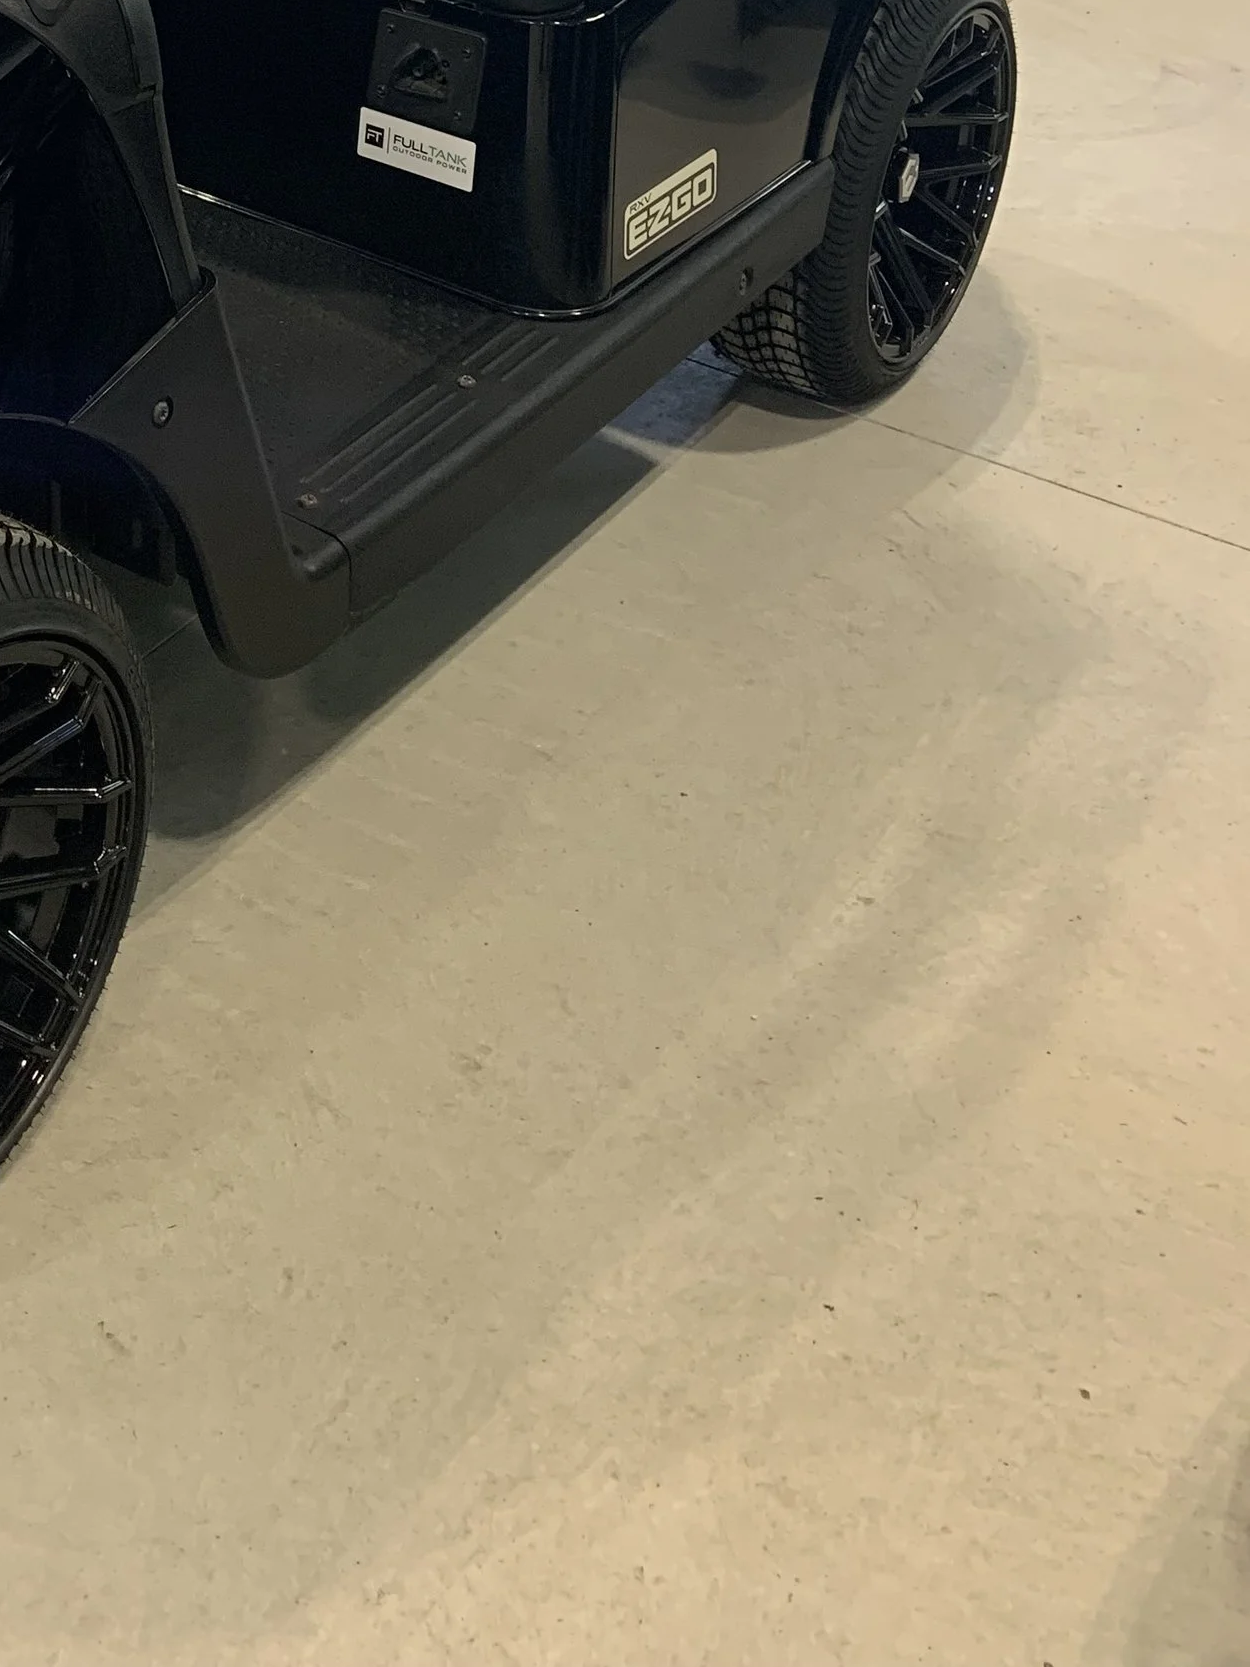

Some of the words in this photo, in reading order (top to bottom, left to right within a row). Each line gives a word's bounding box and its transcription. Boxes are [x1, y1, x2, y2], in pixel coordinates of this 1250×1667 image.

[392, 145, 433, 163] OUTDOOR
[436, 159, 468, 174] POWER
[630, 193, 651, 215] RXV
